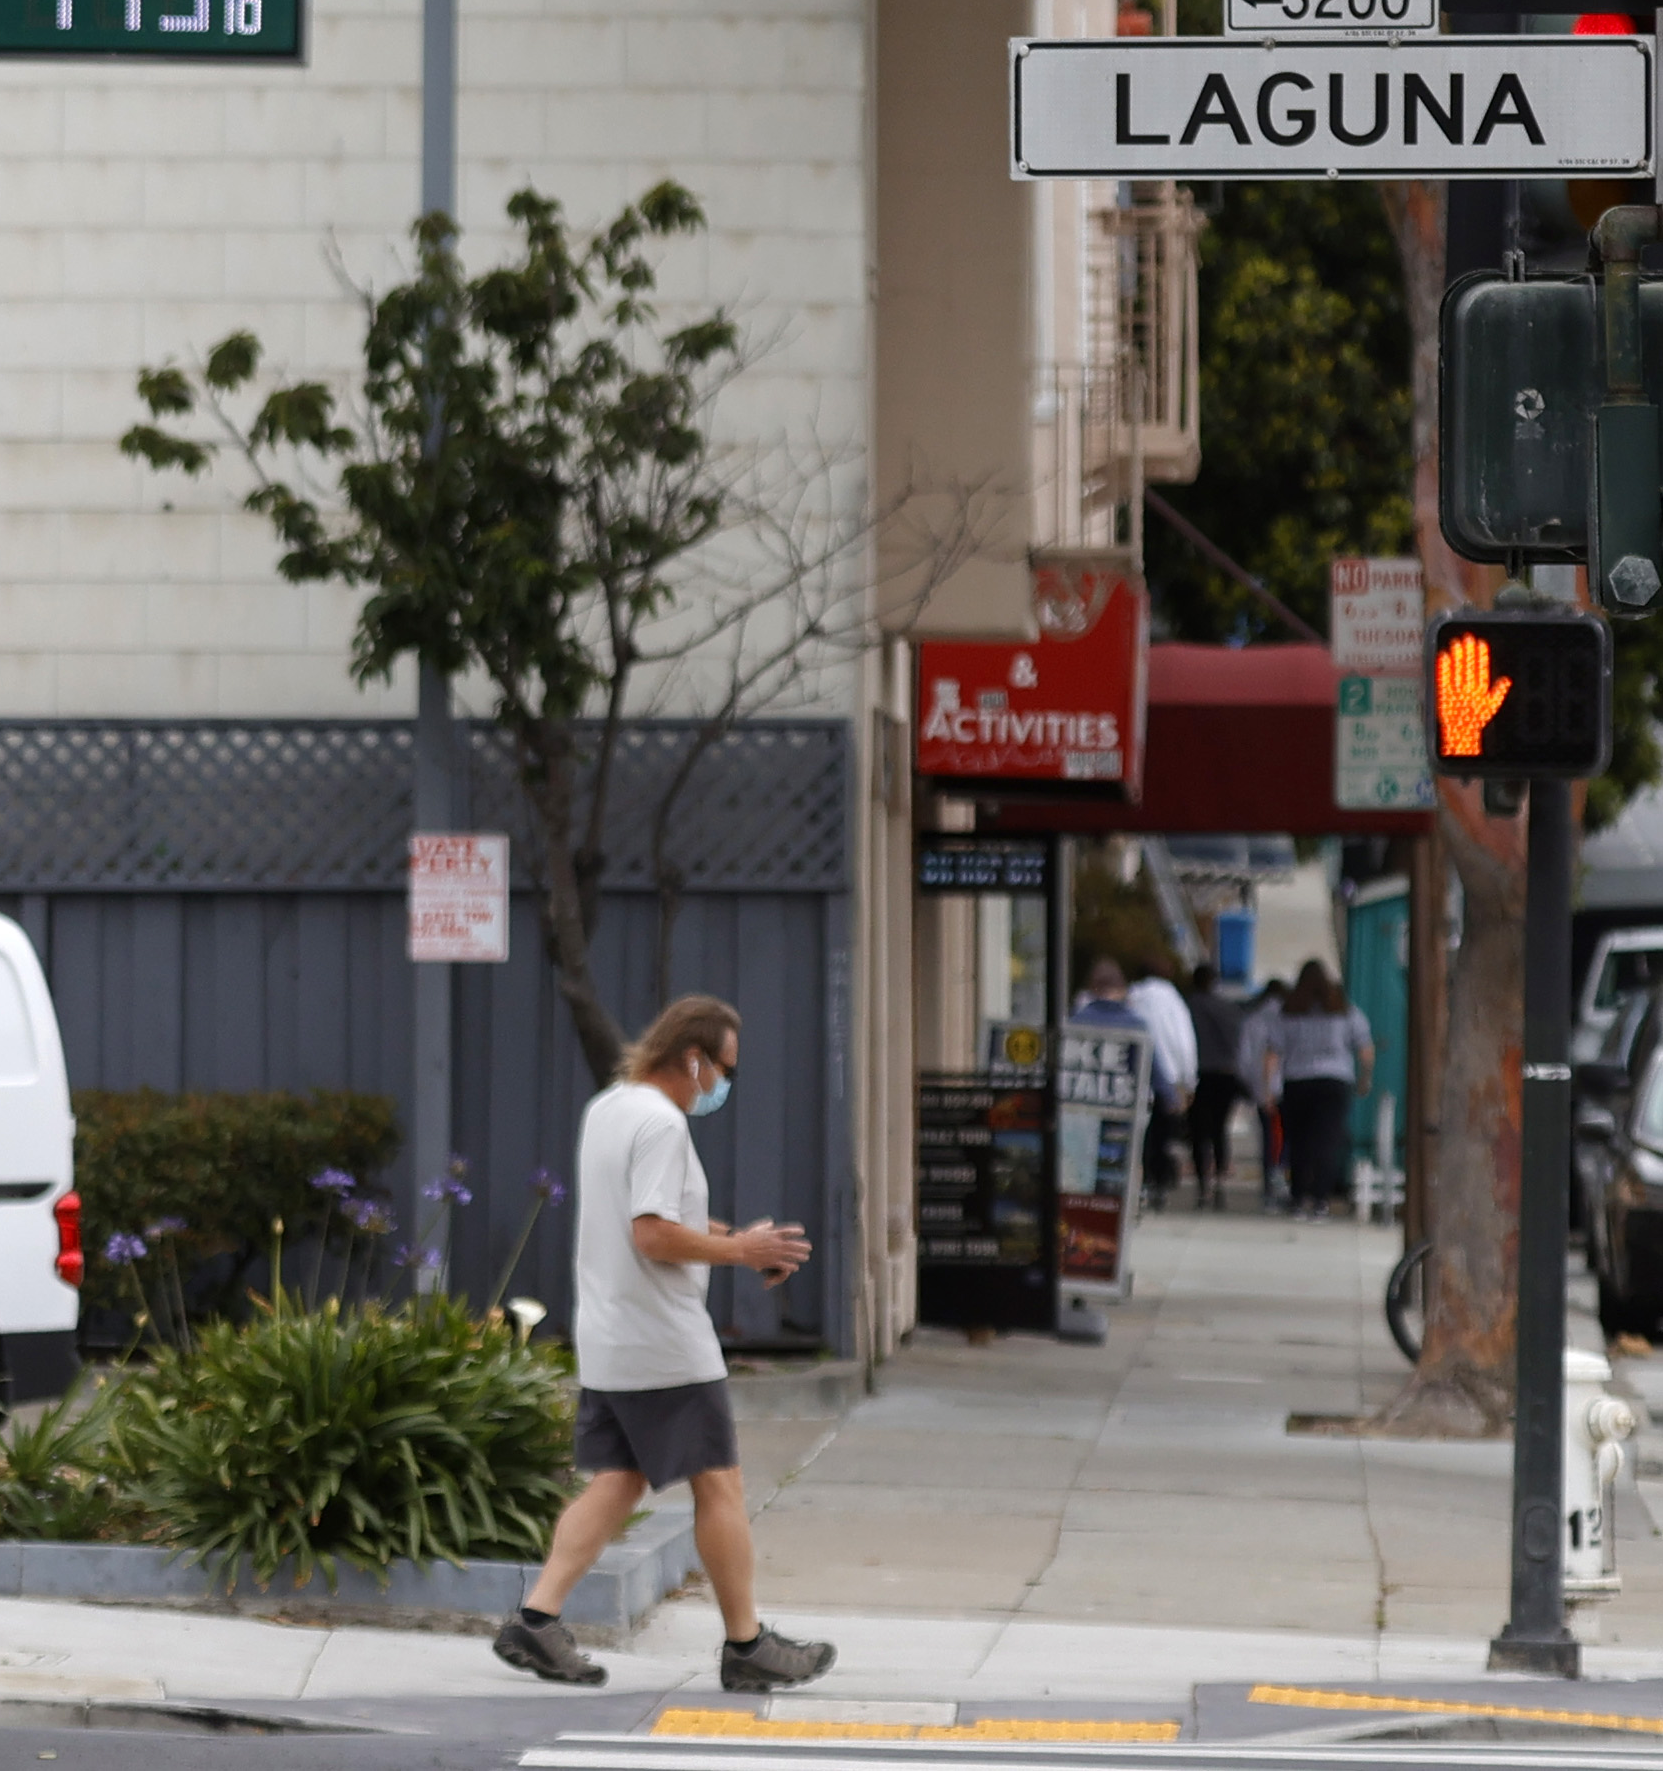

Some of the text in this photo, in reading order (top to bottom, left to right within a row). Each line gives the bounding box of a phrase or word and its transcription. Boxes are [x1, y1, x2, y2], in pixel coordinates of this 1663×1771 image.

[1114, 71, 1547, 148] LAGUNA
[1010, 652, 1038, 689] &
[924, 708, 1120, 749] ACTIVITIES
